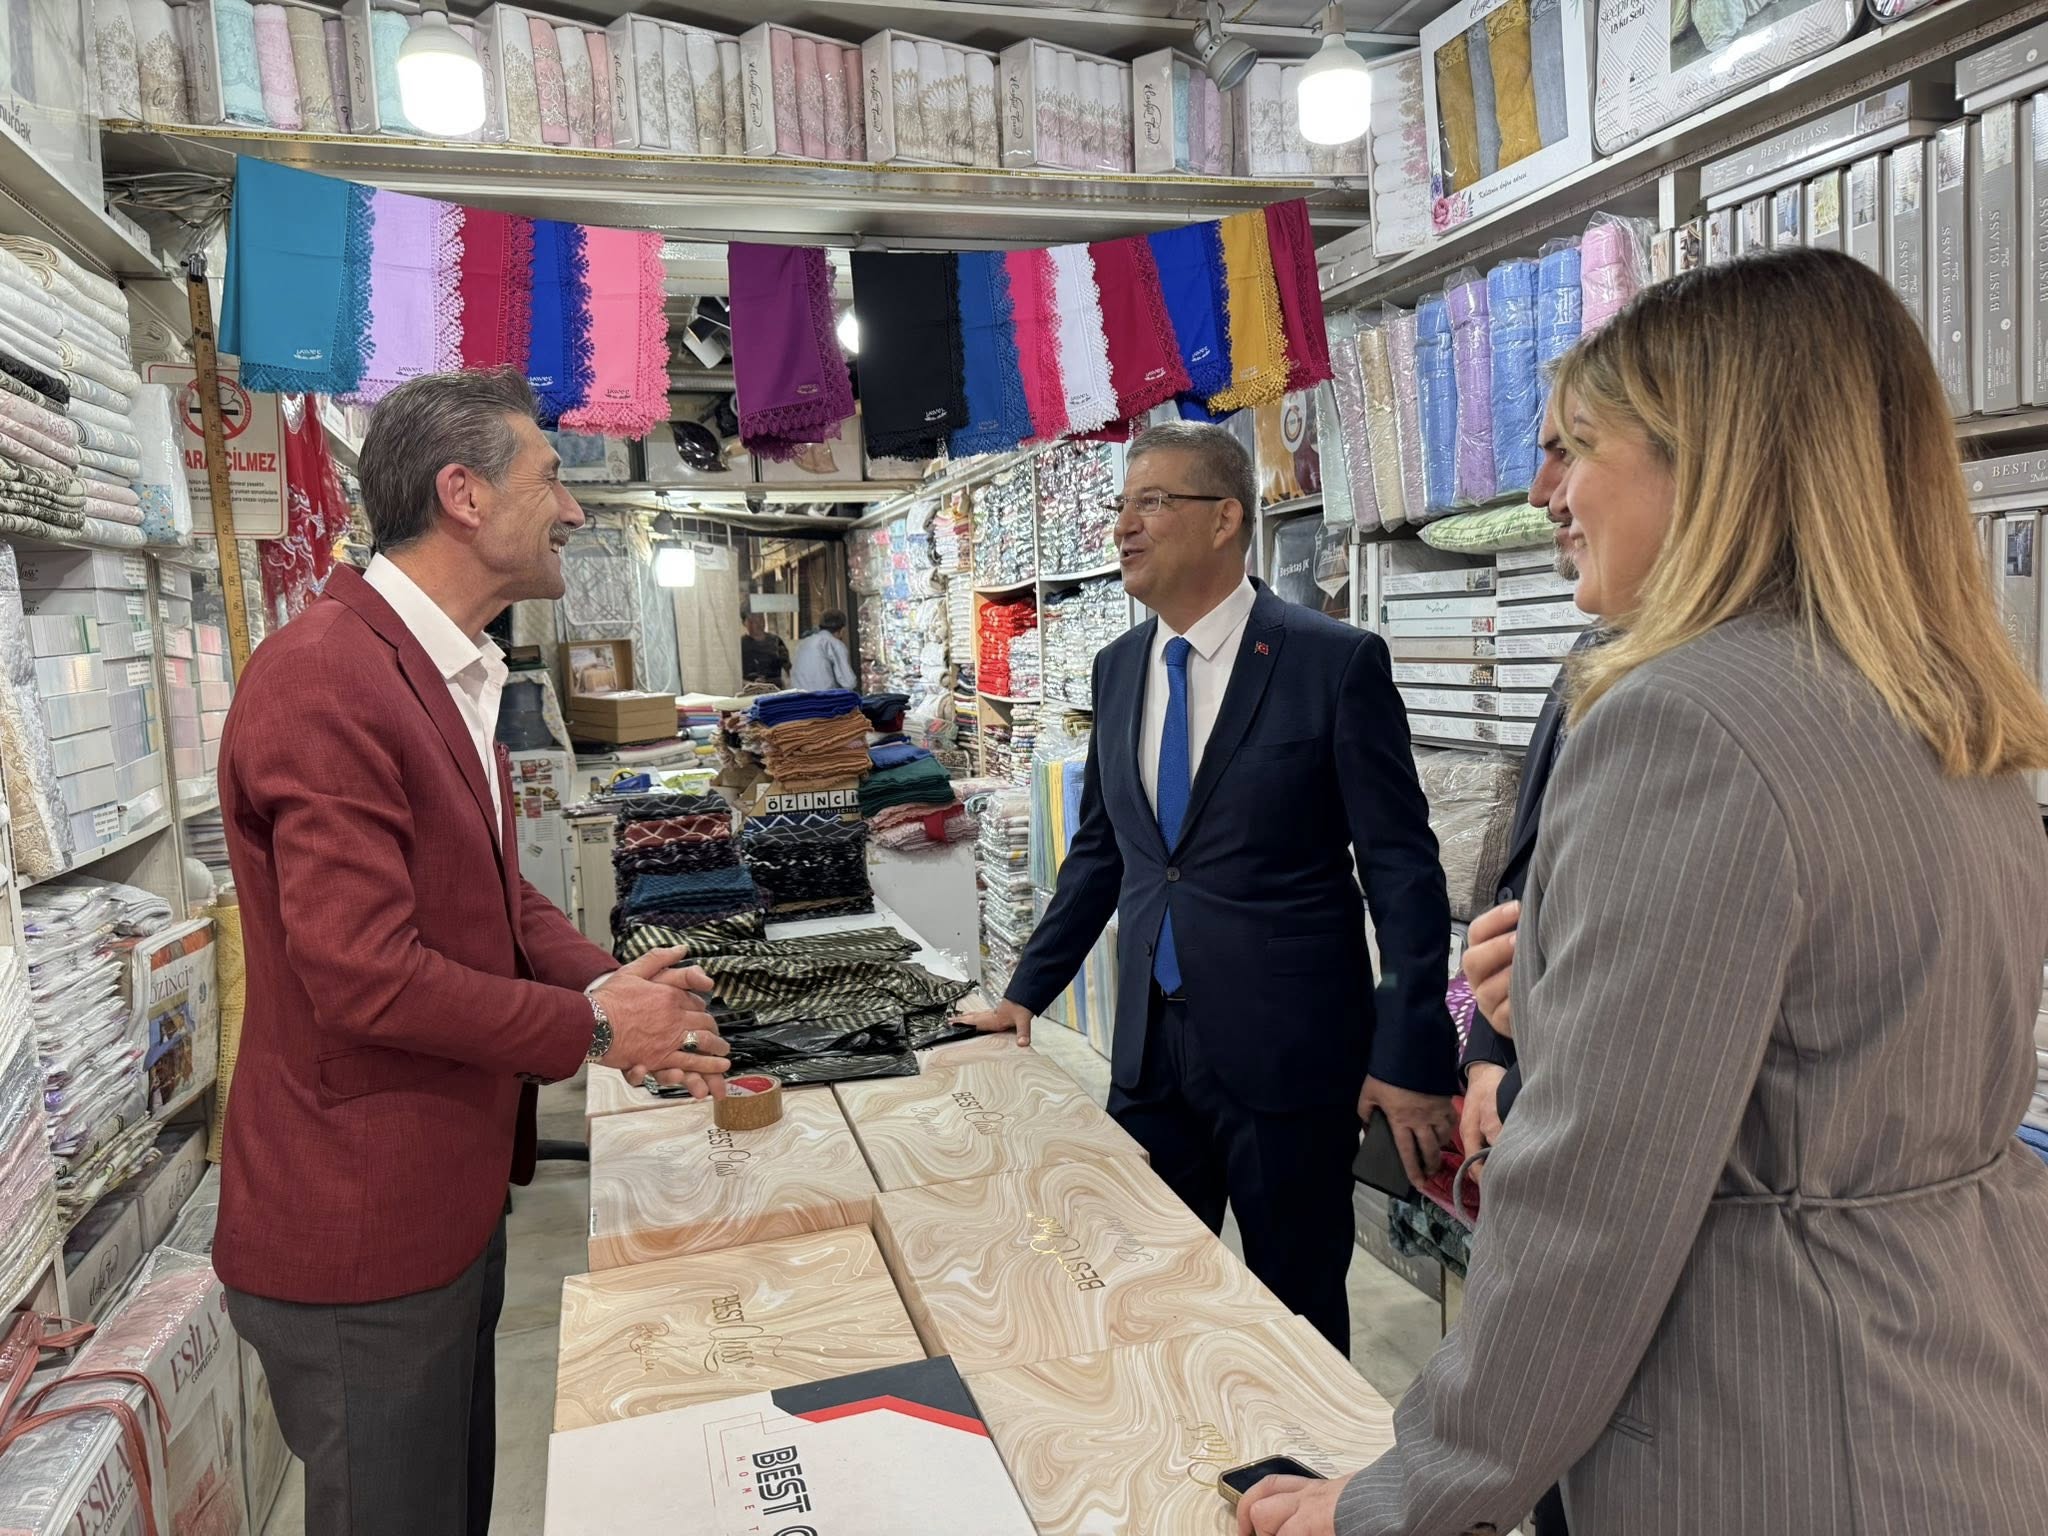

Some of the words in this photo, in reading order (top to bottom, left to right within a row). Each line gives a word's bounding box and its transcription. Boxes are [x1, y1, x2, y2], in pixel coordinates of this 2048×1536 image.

[1760, 139, 1788, 160] BEST
[1792, 120, 1832, 146] CLASS
[1941, 226, 1951, 277] CLASS
[1989, 210, 2000, 263] CLASS
[1942, 287, 1952, 324] BEST
[1989, 272, 2000, 313] BEST
[1992, 461, 2030, 477] BEST
[1279, 561, 1303, 577] Beşiktaş
[768, 791, 855, 810] ÖZİNCİ
[951, 1091, 984, 1111] BEST
[708, 1149, 752, 1178] Class
[1057, 1256, 1106, 1291] BEST
[711, 1294, 745, 1324] BEST
[736, 1455, 756, 1511] HOME
[752, 1445, 812, 1516] BEST
